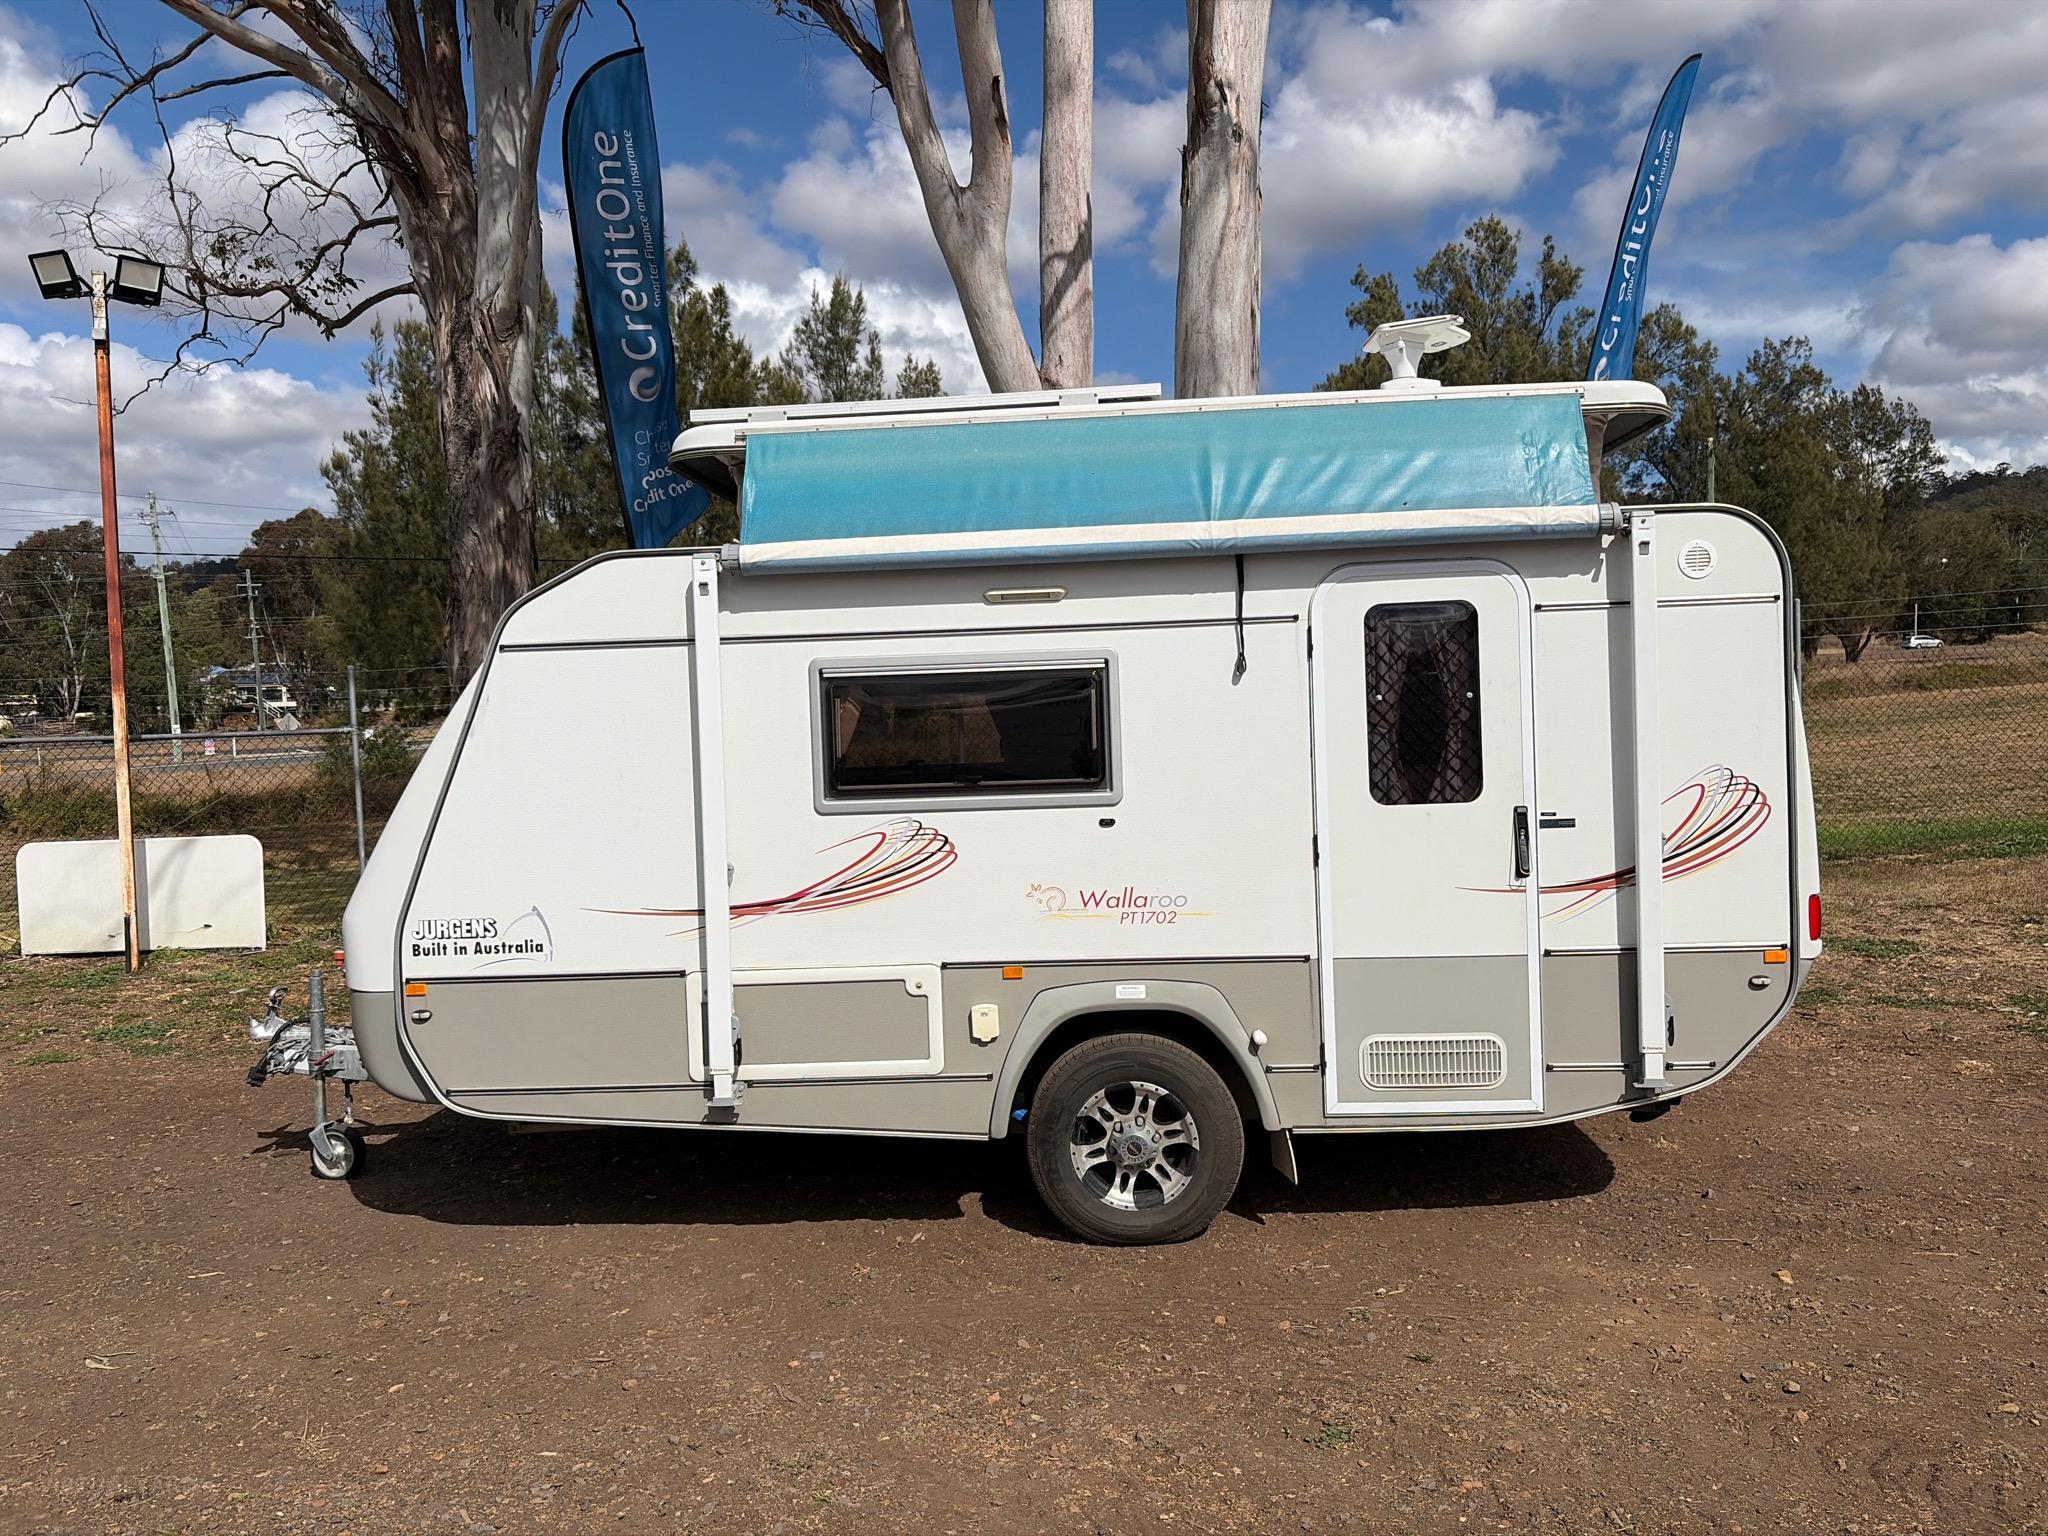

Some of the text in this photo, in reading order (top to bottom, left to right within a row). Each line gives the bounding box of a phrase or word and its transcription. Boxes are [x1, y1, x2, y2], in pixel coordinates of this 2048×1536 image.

[1656, 130, 1674, 186] Insurance
[623, 129, 661, 307] Smarter Finance and Insurance
[594, 131, 657, 360] CreditOne
[1601, 129, 1667, 351] CditO
[633, 479, 693, 512] Cdit One
[1079, 886, 1188, 909] Wallaroo
[411, 917, 498, 940] JURGENS
[1120, 910, 1178, 925] PT1702
[412, 938, 544, 957] Built in Australia
